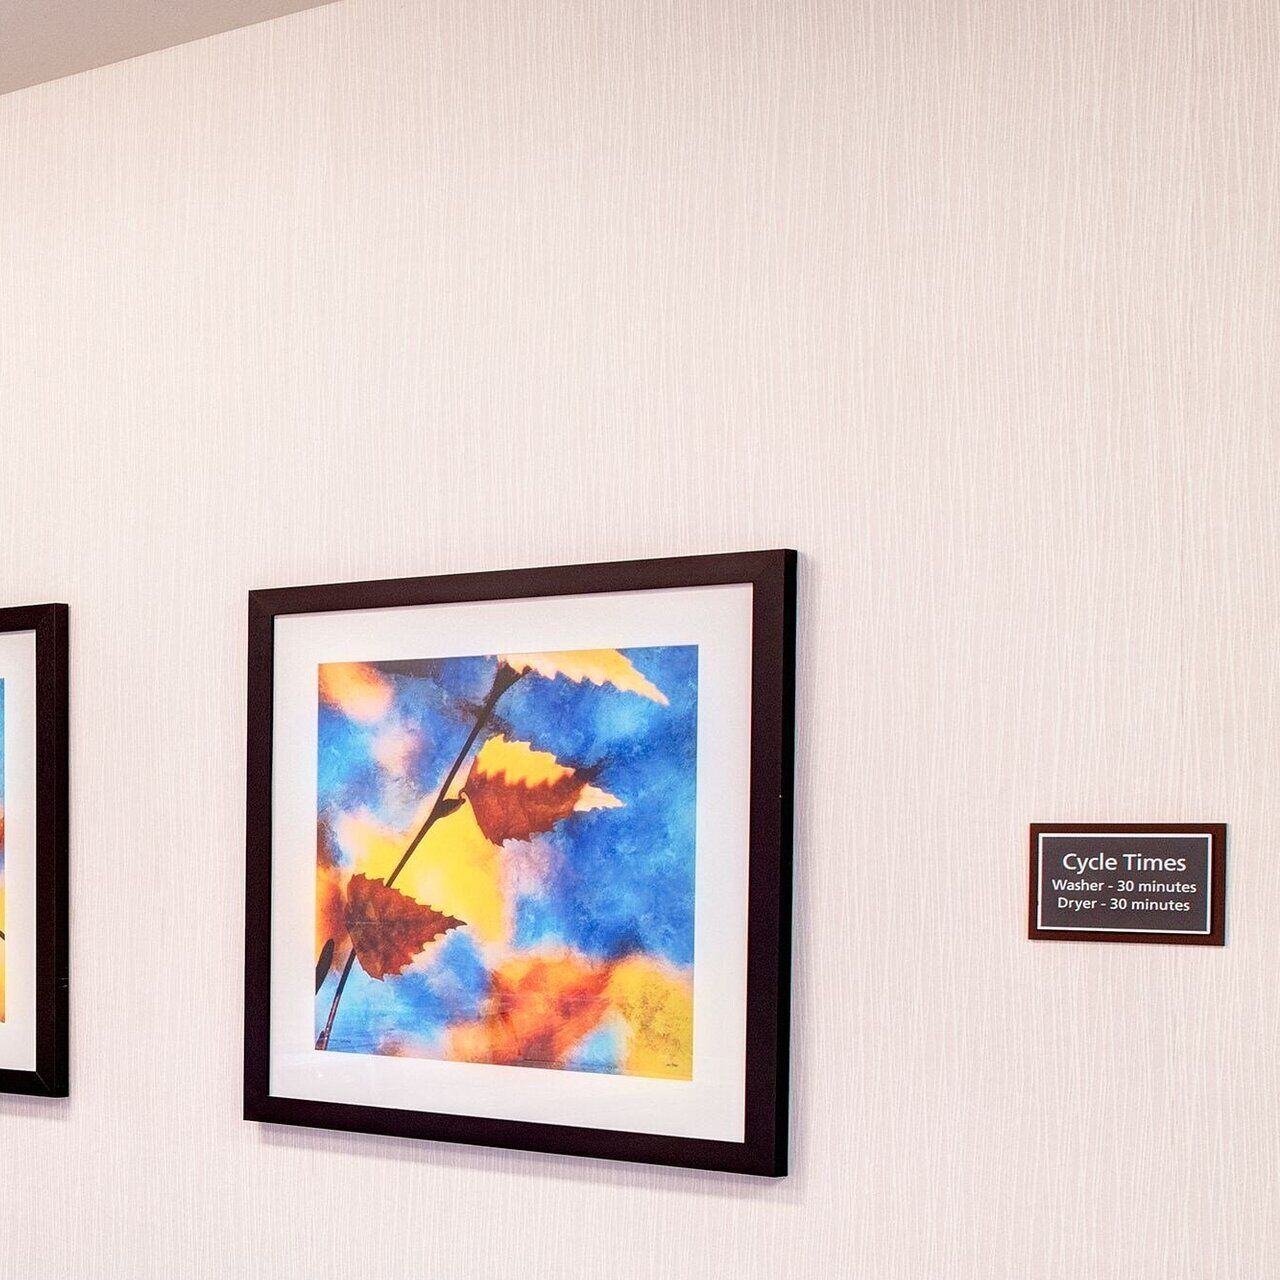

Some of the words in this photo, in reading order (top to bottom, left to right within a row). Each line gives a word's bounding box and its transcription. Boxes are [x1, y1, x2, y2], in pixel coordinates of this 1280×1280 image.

[1062, 852, 1118, 875] Cycle
[1122, 853, 1187, 872] Times
[1052, 879, 1105, 892] Washer
[1117, 880, 1135, 892] 30
[1138, 880, 1197, 893] minutes
[1057, 897, 1098, 912] Dryer
[1110, 898, 1128, 910] 30
[1131, 899, 1191, 912] minutes
